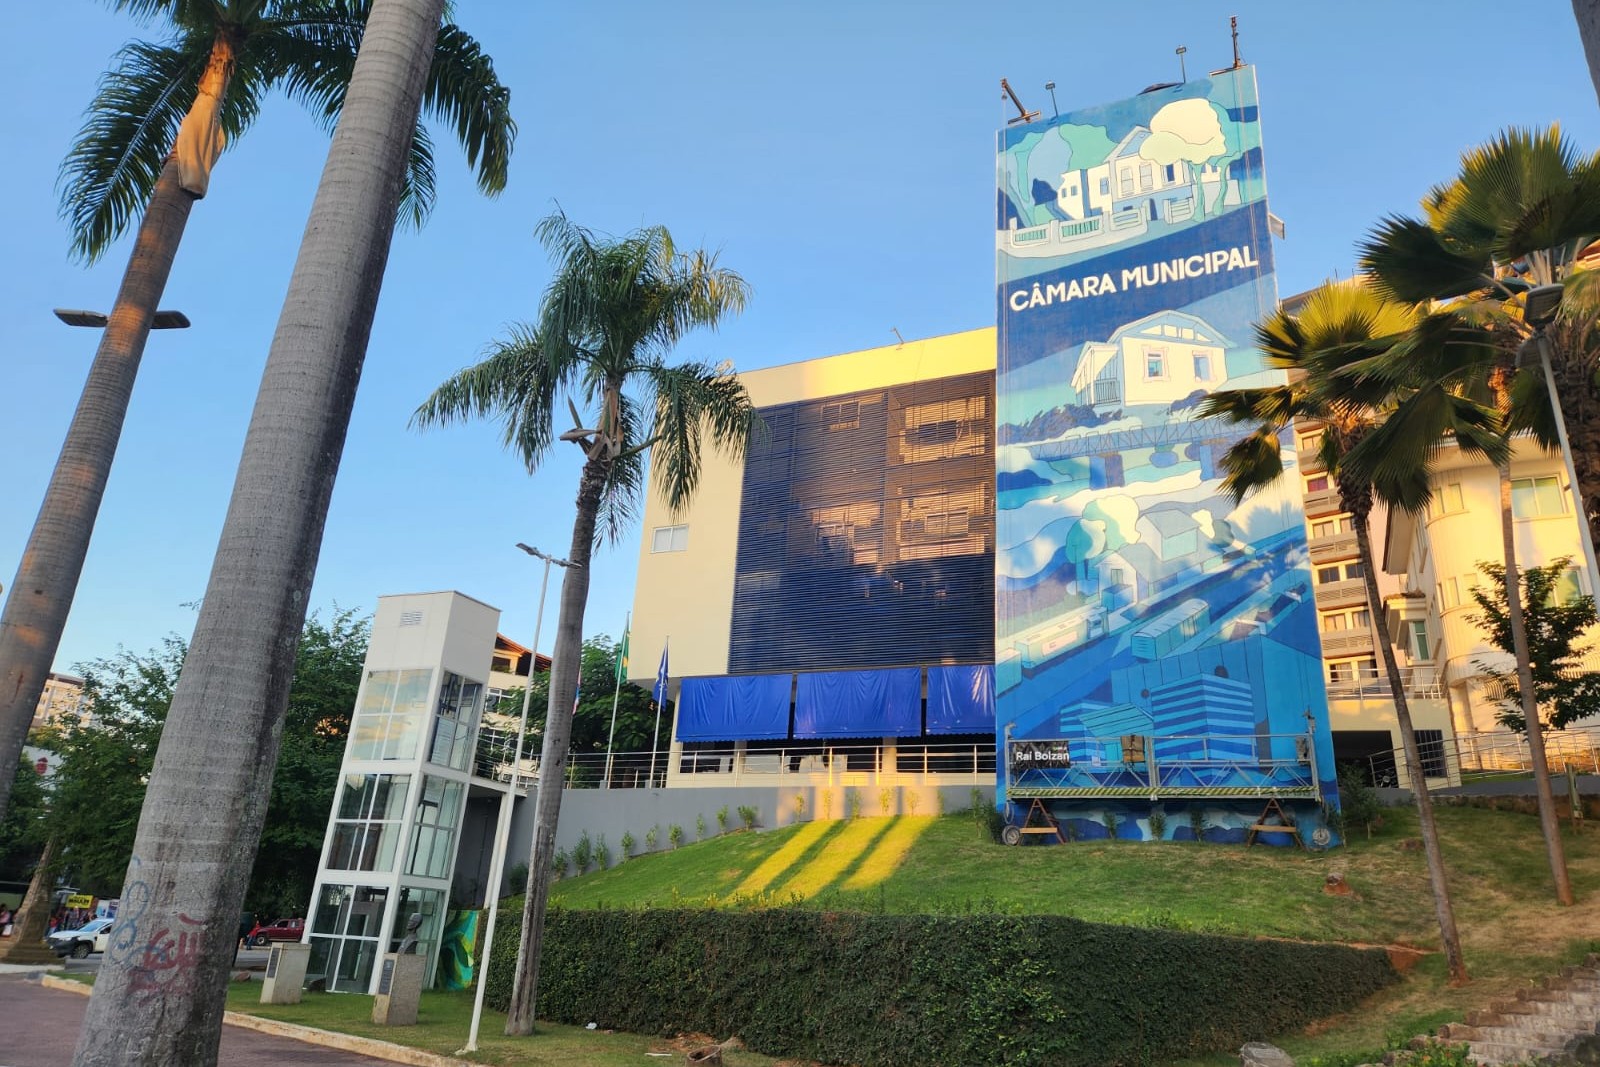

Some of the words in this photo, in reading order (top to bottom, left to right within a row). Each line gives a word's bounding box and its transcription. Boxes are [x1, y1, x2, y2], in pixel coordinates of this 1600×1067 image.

[1010, 273, 1115, 311] CÂMARA
[1121, 246, 1258, 290] MUNICIPAL
[1034, 750, 1070, 761] Bolzan
